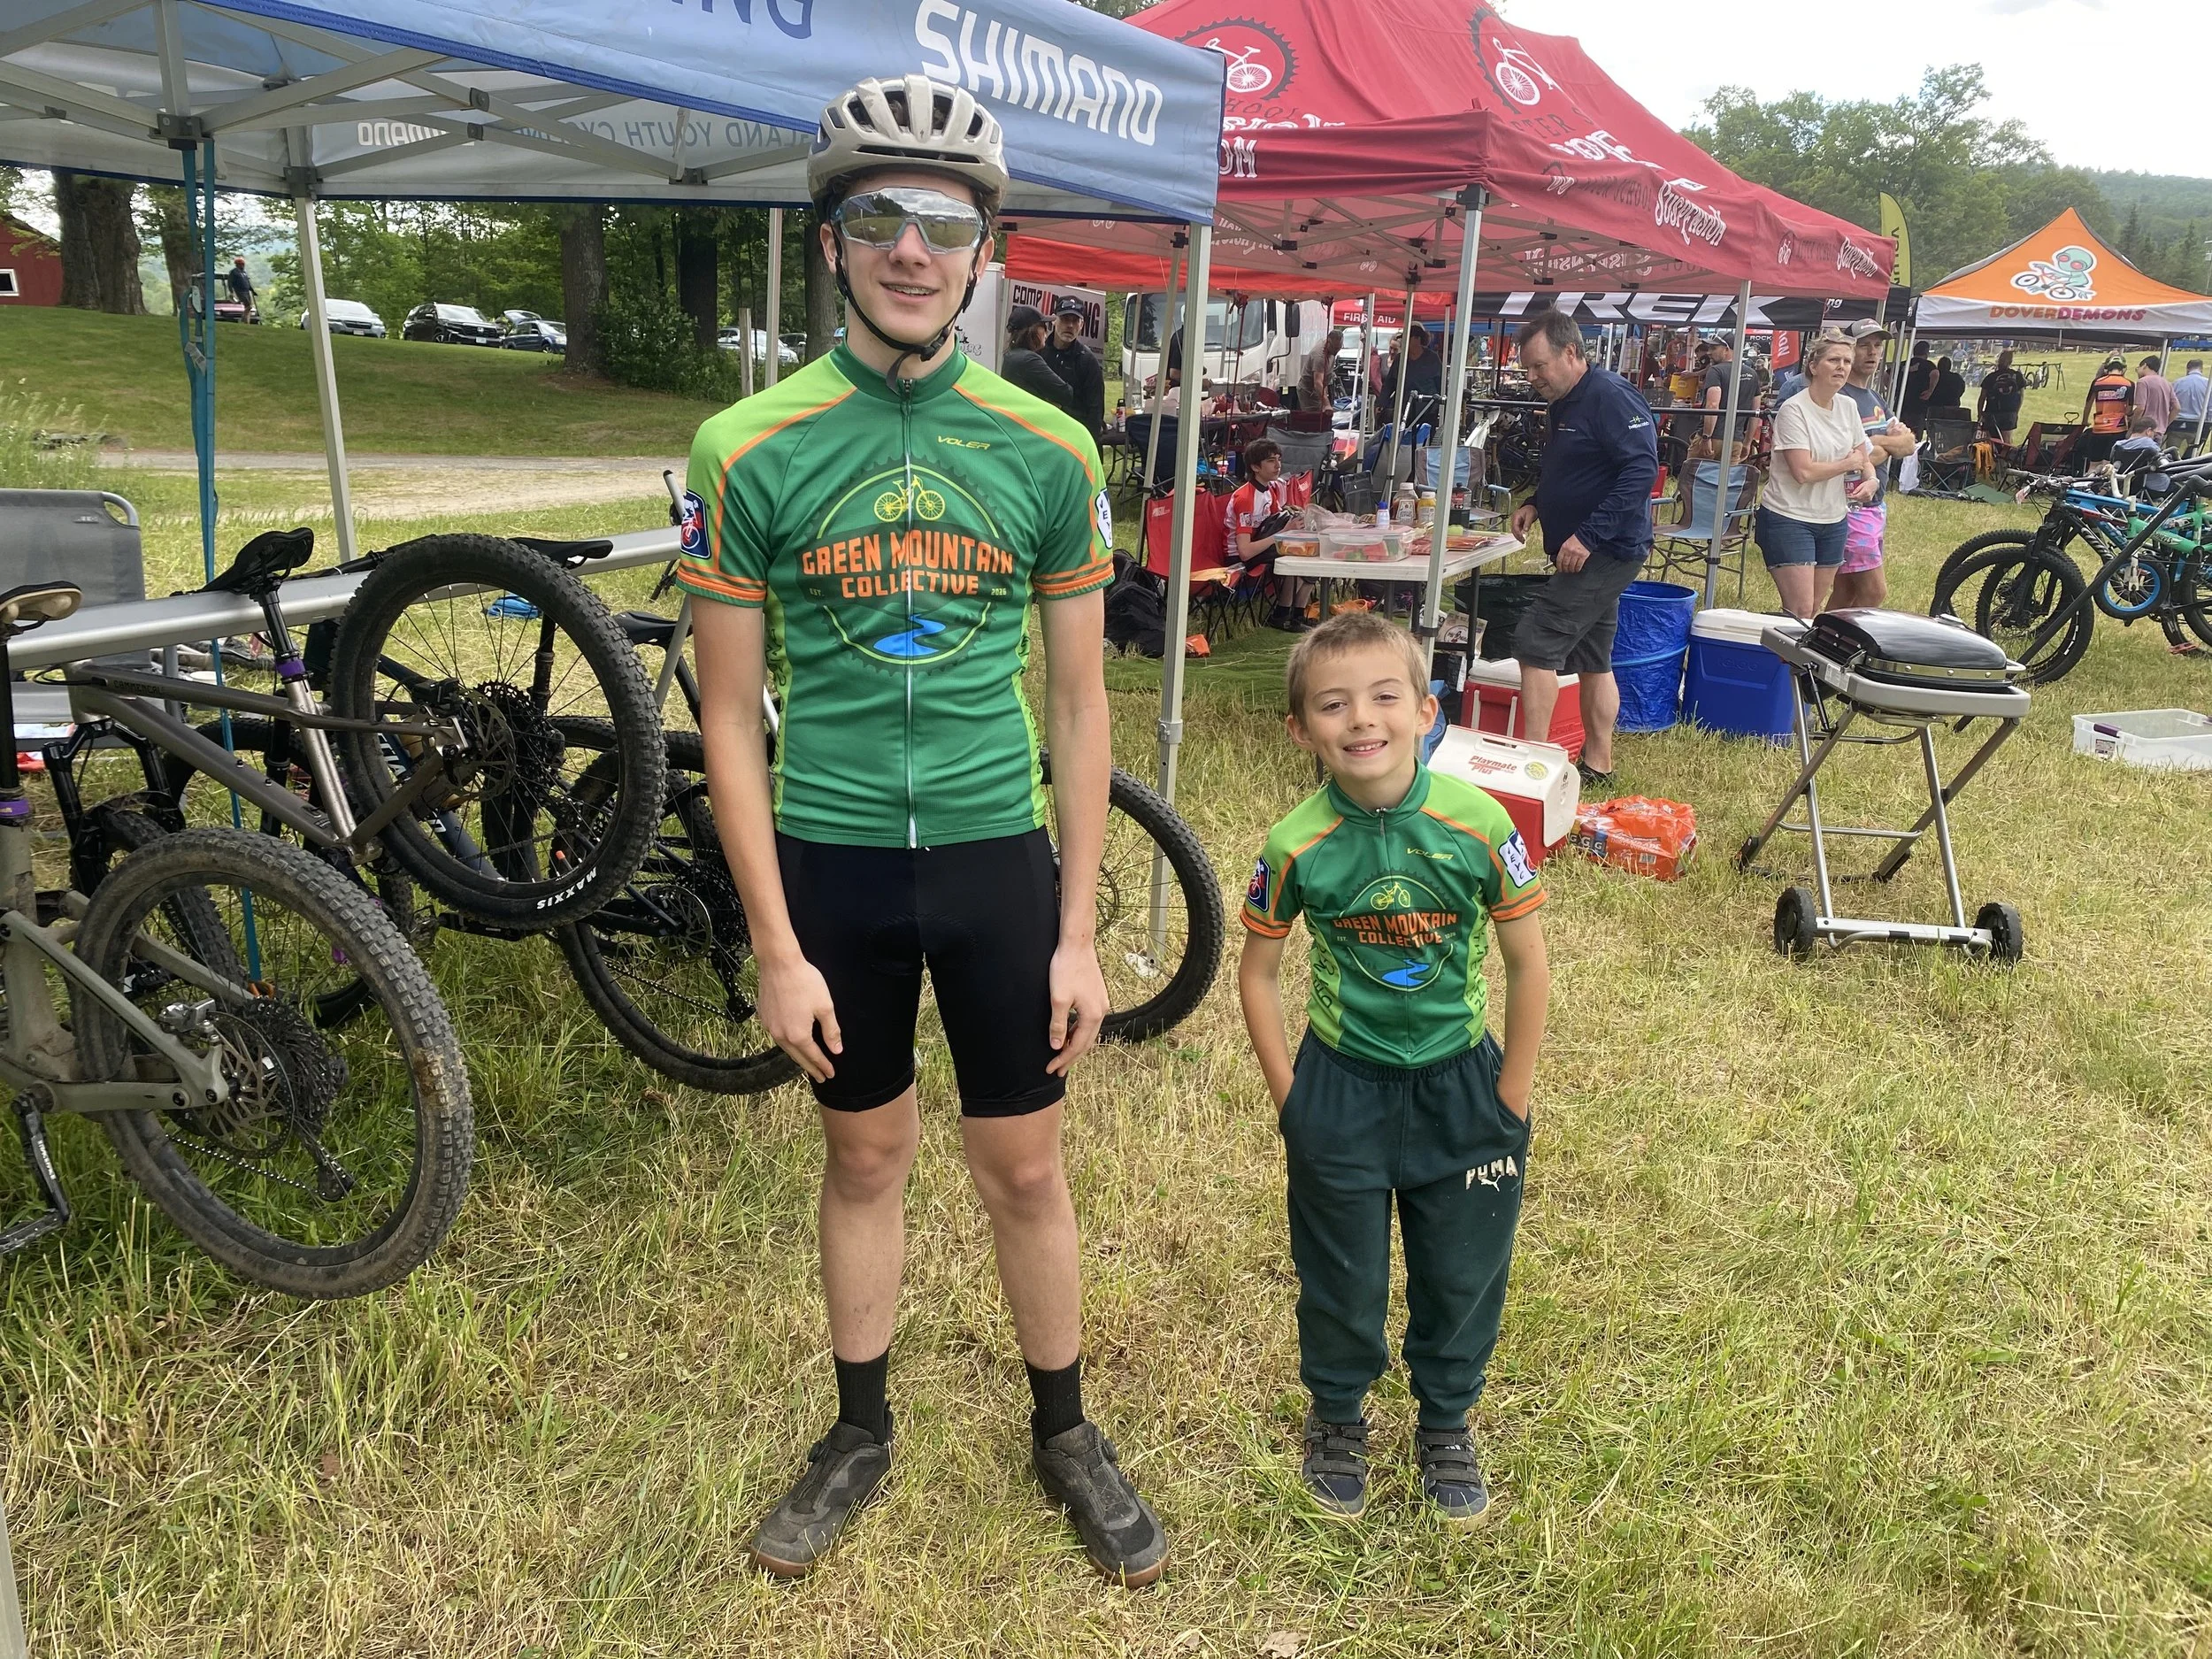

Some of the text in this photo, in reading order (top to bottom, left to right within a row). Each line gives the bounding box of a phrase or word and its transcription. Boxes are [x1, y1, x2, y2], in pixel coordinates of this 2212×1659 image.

[914, 0, 1163, 146] SHIMANO
[1343, 312, 1396, 324] FIRS AID
[1990, 306, 2147, 321] DOVERDEMONS
[938, 435, 991, 450] VOLER
[802, 529, 1014, 575] GREEN MOUNTAIN
[810, 588, 825, 597] EST.
[841, 570, 979, 599] COLLECTIVE
[1471, 755, 1517, 771] Playmate
[1471, 764, 1493, 775] Plus
[1581, 836, 1591, 847] G
[1594, 841, 1603, 849] G
[1407, 848, 1454, 860] VOLER
[536, 866, 597, 910] MAXXIS
[1333, 912, 1457, 936] GREEN MOUNTAIN
[1358, 931, 1443, 948] COLLECTIVE
[1465, 1156, 1518, 1190] PUMA
